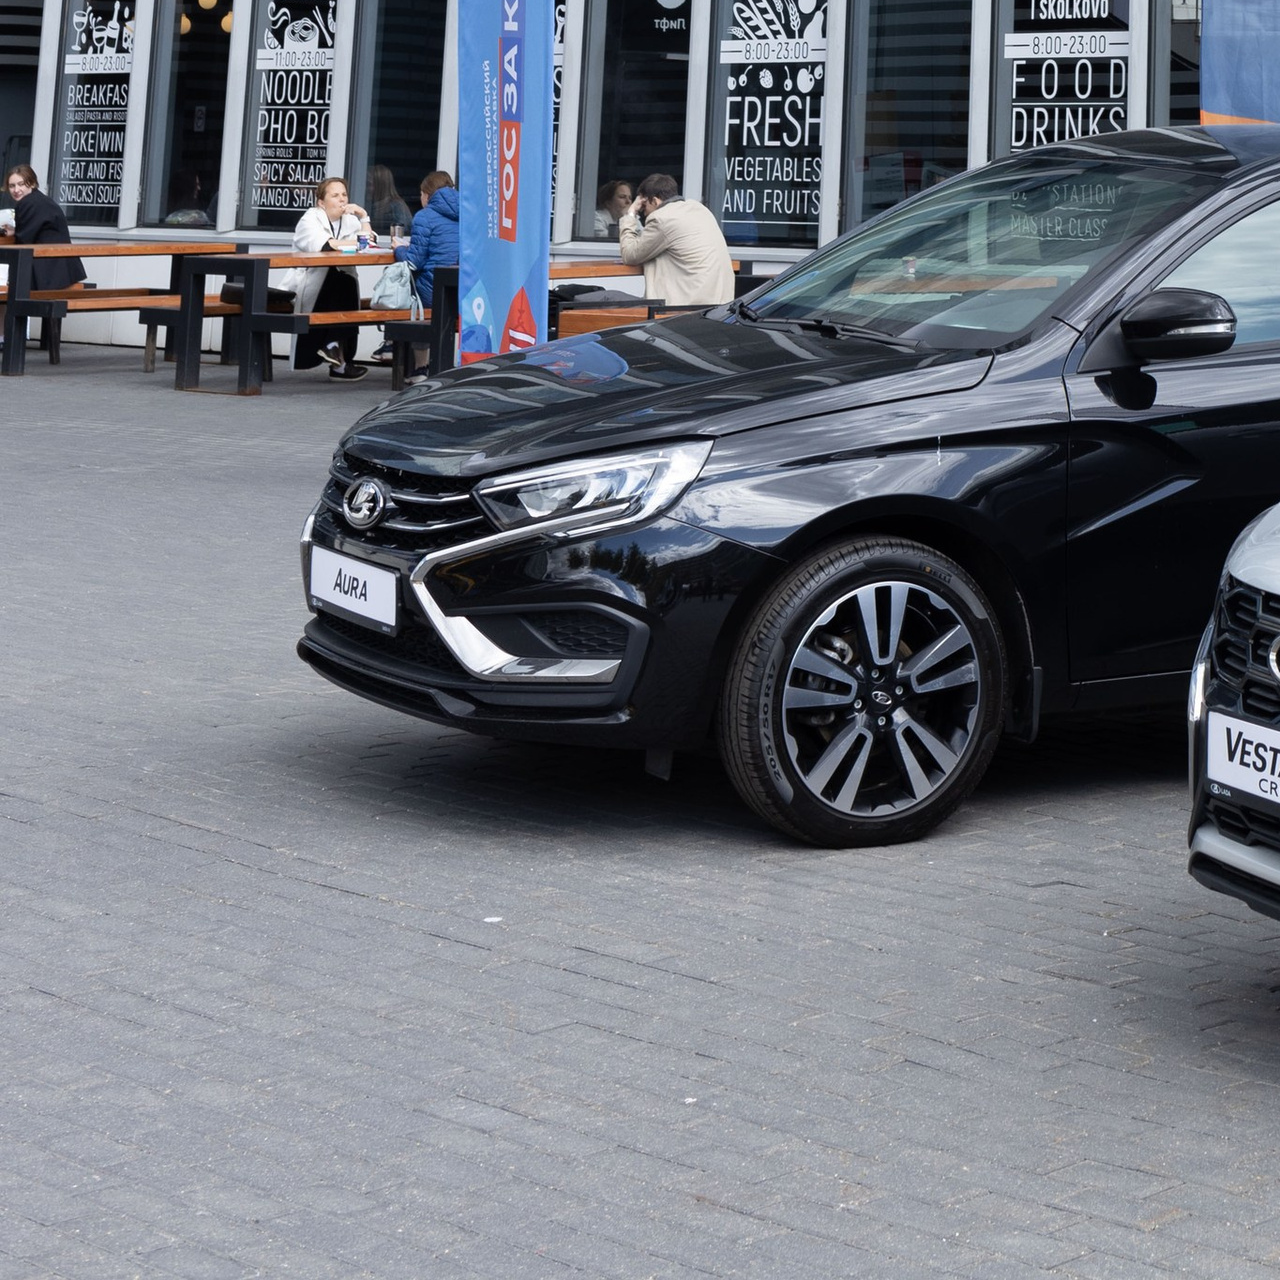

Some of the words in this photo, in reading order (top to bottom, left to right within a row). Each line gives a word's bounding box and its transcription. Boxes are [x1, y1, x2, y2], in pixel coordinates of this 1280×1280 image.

[744, 41, 810, 61] 8:00-23:00
[1032, 34, 1107, 55] 8:00-23:00
[81, 56, 126, 71] 8:00-23:00
[275, 51, 327, 67] 11:00-23:00
[1012, 58, 1126, 100] FOOD
[257, 110, 297, 143] PHO
[724, 94, 825, 148] FRESH
[1011, 106, 1126, 147] DRINKS
[63, 131, 95, 152] POKE
[61, 162, 86, 179] MEAT
[86, 162, 106, 179] AND
[254, 162, 285, 182] SPICY
[724, 156, 823, 183] VEGETABLES
[59, 184, 94, 203] SNACKS
[251, 187, 290, 207] MANGO
[722, 189, 756, 213] AND
[763, 189, 821, 215] FRUITS
[333, 567, 368, 602] AURA
